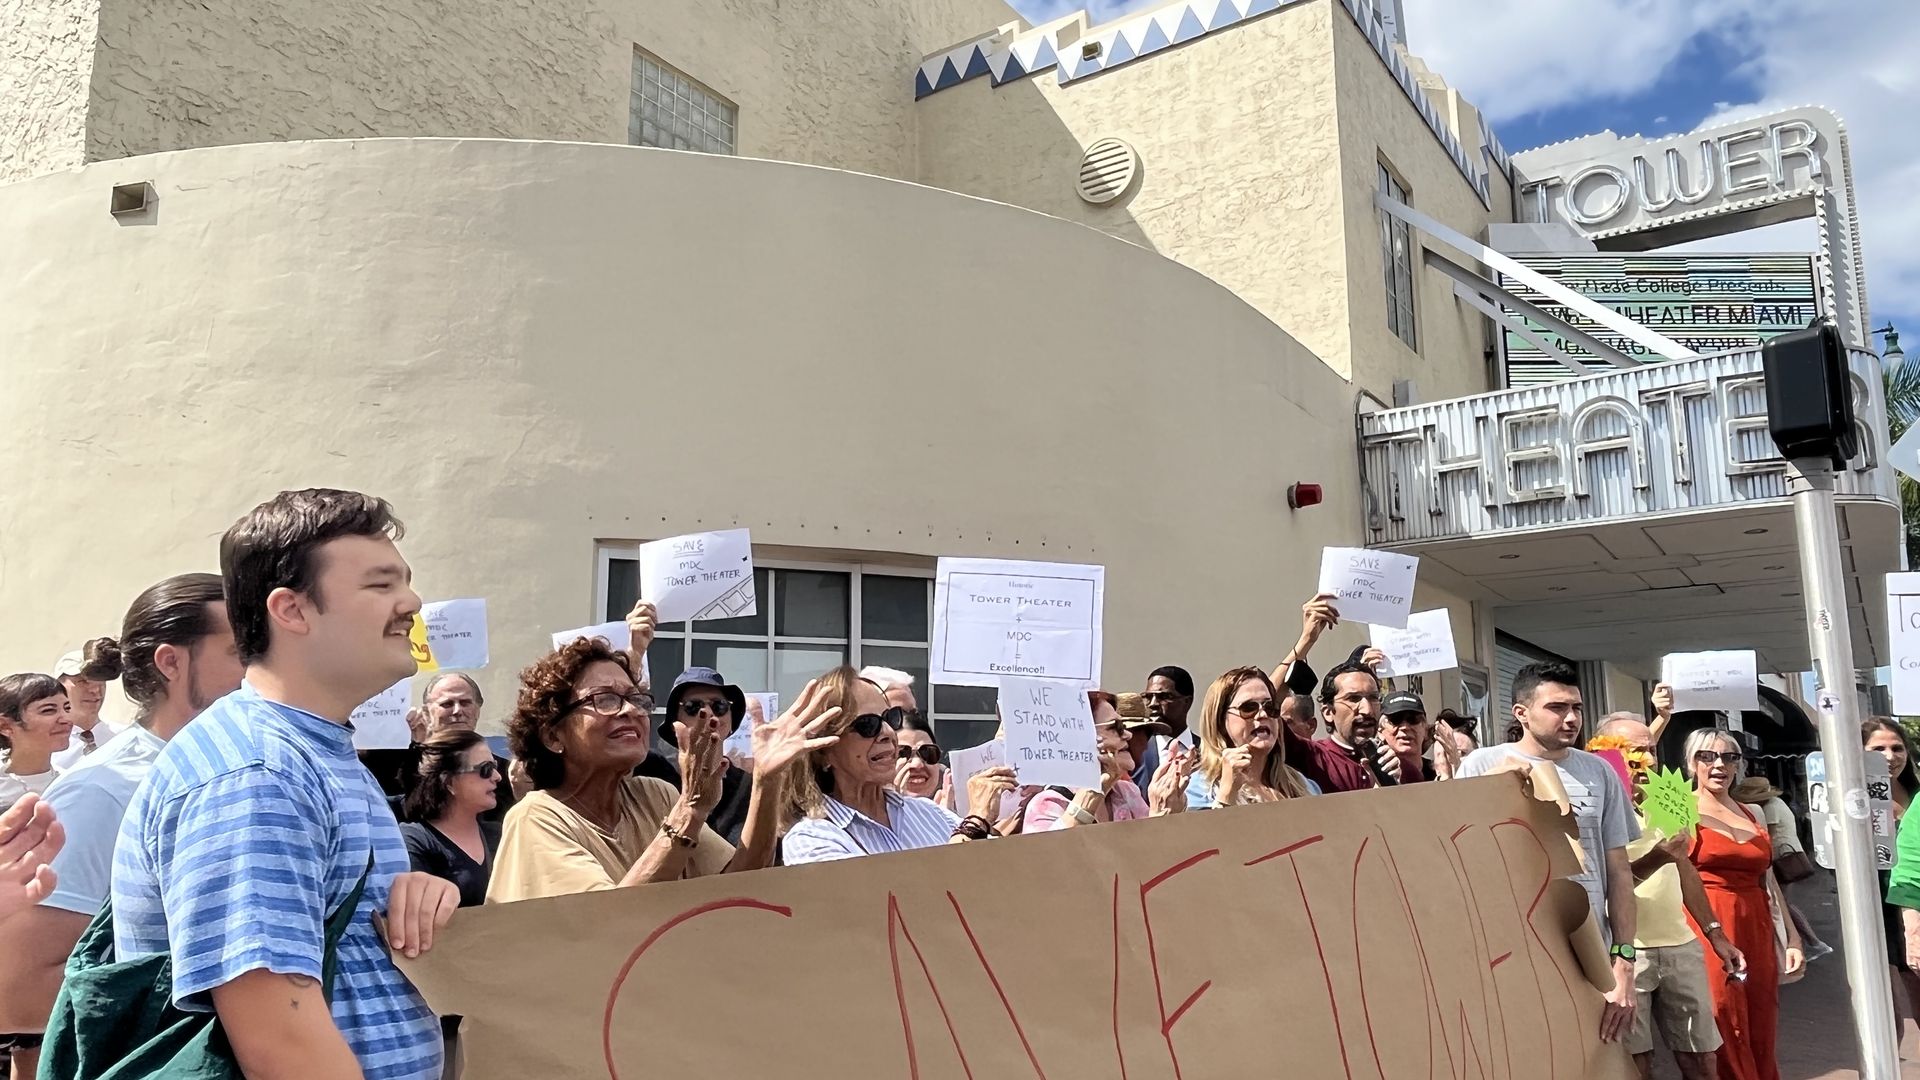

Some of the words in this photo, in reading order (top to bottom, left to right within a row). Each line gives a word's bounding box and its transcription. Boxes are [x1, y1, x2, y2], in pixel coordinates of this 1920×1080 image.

[1520, 118, 1822, 227] TOWER
[1729, 305, 1803, 325] MIAMI
[673, 539, 704, 553] SAVE
[1350, 555, 1382, 570] SAVE
[665, 575, 698, 587] TOWER
[701, 569, 741, 582] THEATER
[1353, 577, 1377, 590] MDC
[970, 594, 1011, 605] TOWER
[1017, 596, 1073, 609] THEATER
[1334, 587, 1363, 600] TOWER
[1370, 592, 1405, 606] THEATER
[442, 632, 472, 641] THEATER
[1007, 631, 1033, 642] MDC
[989, 663, 1046, 675] Excellence!!
[1029, 687, 1052, 707] WE
[1014, 710, 1057, 728] STAND
[1061, 718, 1085, 731] WITH
[1038, 731, 1060, 746] MDC
[980, 744, 997, 765] WE
[1020, 747, 1056, 762] TOWER
[1058, 749, 1095, 764] THEATER
